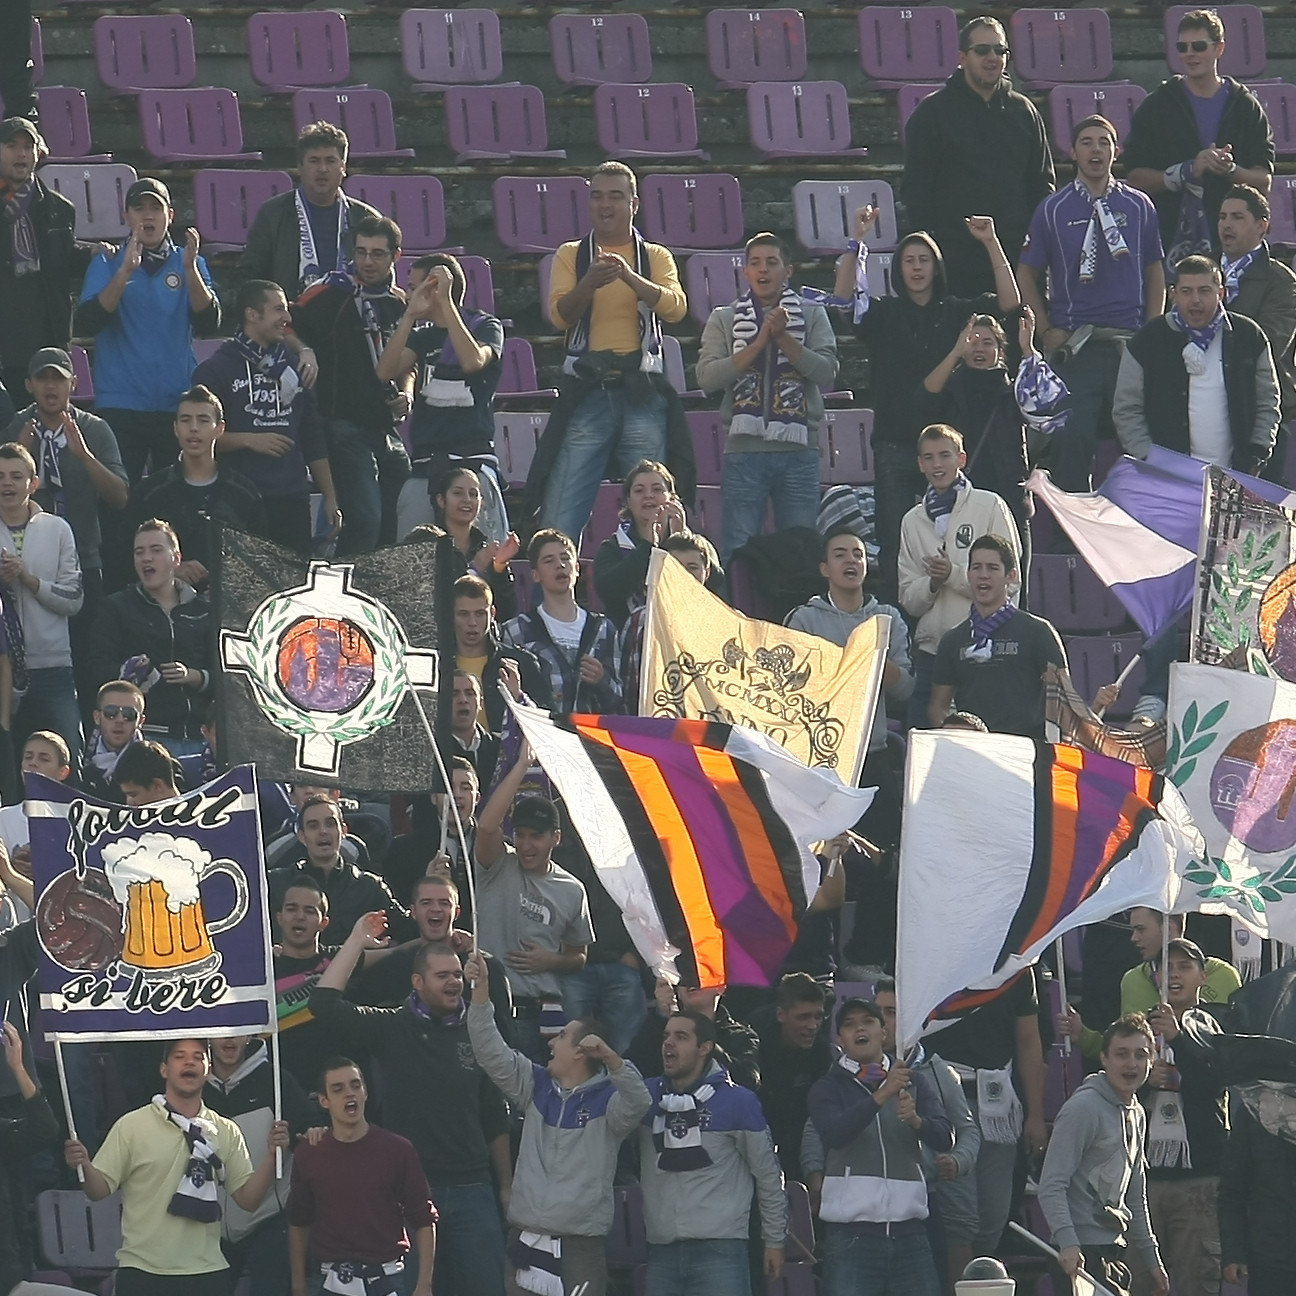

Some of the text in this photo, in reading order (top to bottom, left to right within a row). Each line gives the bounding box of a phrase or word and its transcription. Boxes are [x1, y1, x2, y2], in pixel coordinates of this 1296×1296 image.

[747, 11, 761, 22] 14
[900, 9, 913, 19] 13
[1052, 10, 1066, 21] 15
[591, 17, 604, 27] 12
[637, 87, 650, 97] 12
[792, 85, 803, 96] 13
[1093, 91, 1106, 100] 15
[83, 170, 90, 180] 8
[684, 179, 696, 188] 12
[529, 416, 542, 426] 10
[823, 412, 837, 422] 12
[1111, 641, 1122, 653] 13
[704, 677, 801, 724] MCMXXI
[123, 970, 228, 1015] bere
